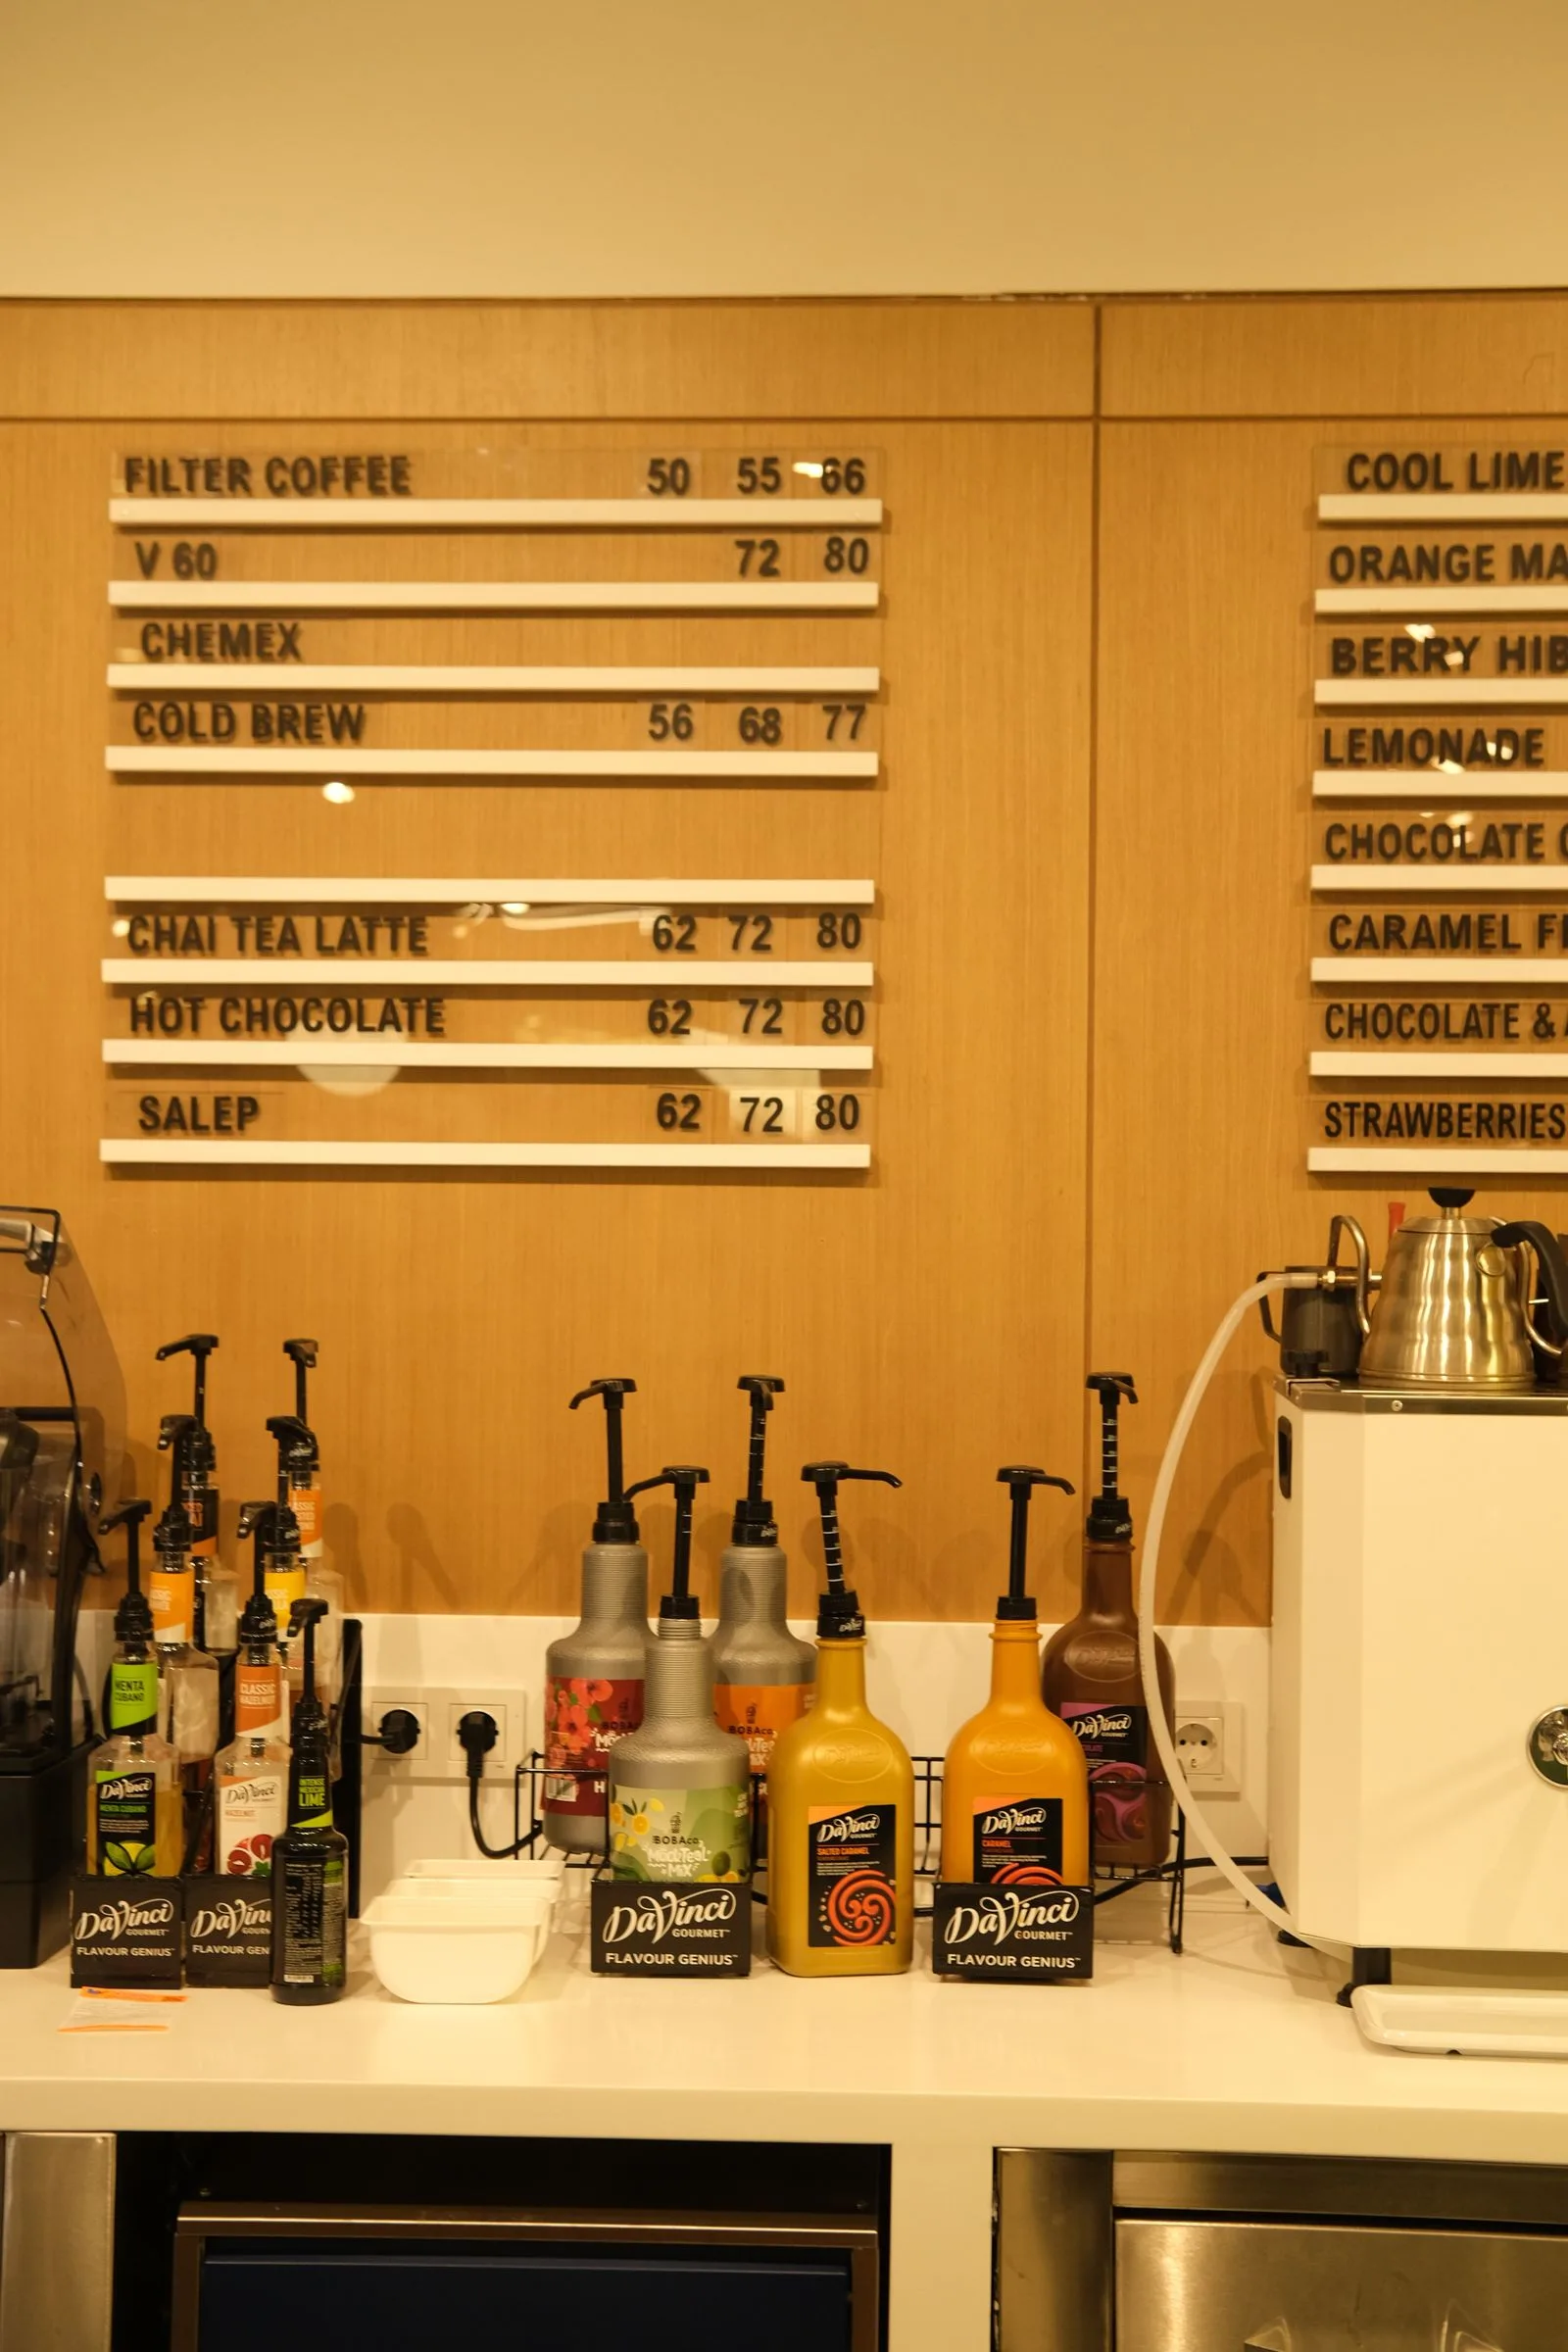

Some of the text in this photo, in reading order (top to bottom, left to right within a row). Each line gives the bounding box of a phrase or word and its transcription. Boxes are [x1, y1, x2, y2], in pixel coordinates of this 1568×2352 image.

[124, 455, 412, 496] FILTER COFFEE
[647, 458, 691, 495] 50
[737, 457, 781, 495] 55
[820, 458, 866, 495] 66
[1347, 451, 1565, 491] COOL LIME
[134, 542, 218, 580] V 60
[734, 541, 781, 578] 72
[824, 537, 869, 574] 80
[1329, 544, 1568, 582] ORANGE MA
[141, 621, 303, 662] CHEMEX
[1331, 635, 1568, 675] BERRY HIB
[133, 702, 367, 745] COLD BREW
[649, 705, 693, 742] 56
[739, 707, 782, 745] 68
[822, 705, 867, 741] 77
[1324, 727, 1545, 765] LEMONADE
[1325, 822, 1545, 861] CHOCOLATE
[127, 914, 428, 956] CHAI TEA LATTE
[652, 914, 698, 953] 62
[727, 914, 773, 953] 72
[815, 912, 862, 951] 80
[1329, 913, 1522, 952] CARAMEL
[129, 997, 445, 1035] HOT CHOCOLATE
[647, 999, 693, 1036] 62
[739, 998, 784, 1036] 72
[821, 998, 866, 1036] 80
[1325, 1003, 1520, 1041] CHOCOLATE
[1532, 1003, 1556, 1040] &
[138, 1095, 261, 1134] SALEP
[656, 1093, 702, 1131] 62
[739, 1096, 785, 1134] 72
[814, 1093, 860, 1131] 80
[1324, 1102, 1566, 1141] STRAWBERRIES
[239, 1683, 275, 1695] CLASSIC
[601, 1722, 638, 1731] BOBA
[1073, 1713, 1132, 1740] DaVinci
[100, 1777, 153, 1799] DaVinci
[299, 1792, 325, 1807] LIME
[816, 1813, 881, 1842] DaVinci
[981, 1806, 1047, 1835] DaVinci
[74, 1898, 174, 1940] DaVinci
[603, 1887, 737, 1944] DaVinci
[671, 1928, 725, 1938] GOURMET
[945, 1890, 1080, 1945] DaVinci
[76, 1946, 172, 1957] FLAVOUR GENIUS
[192, 1944, 245, 1955] FLAVOUR
[1013, 1930, 1068, 1941] GOURMET
[606, 1952, 734, 1966] FLAVOUR GENIUS
[947, 1953, 1076, 1969] FLAVOUR GENIUS
